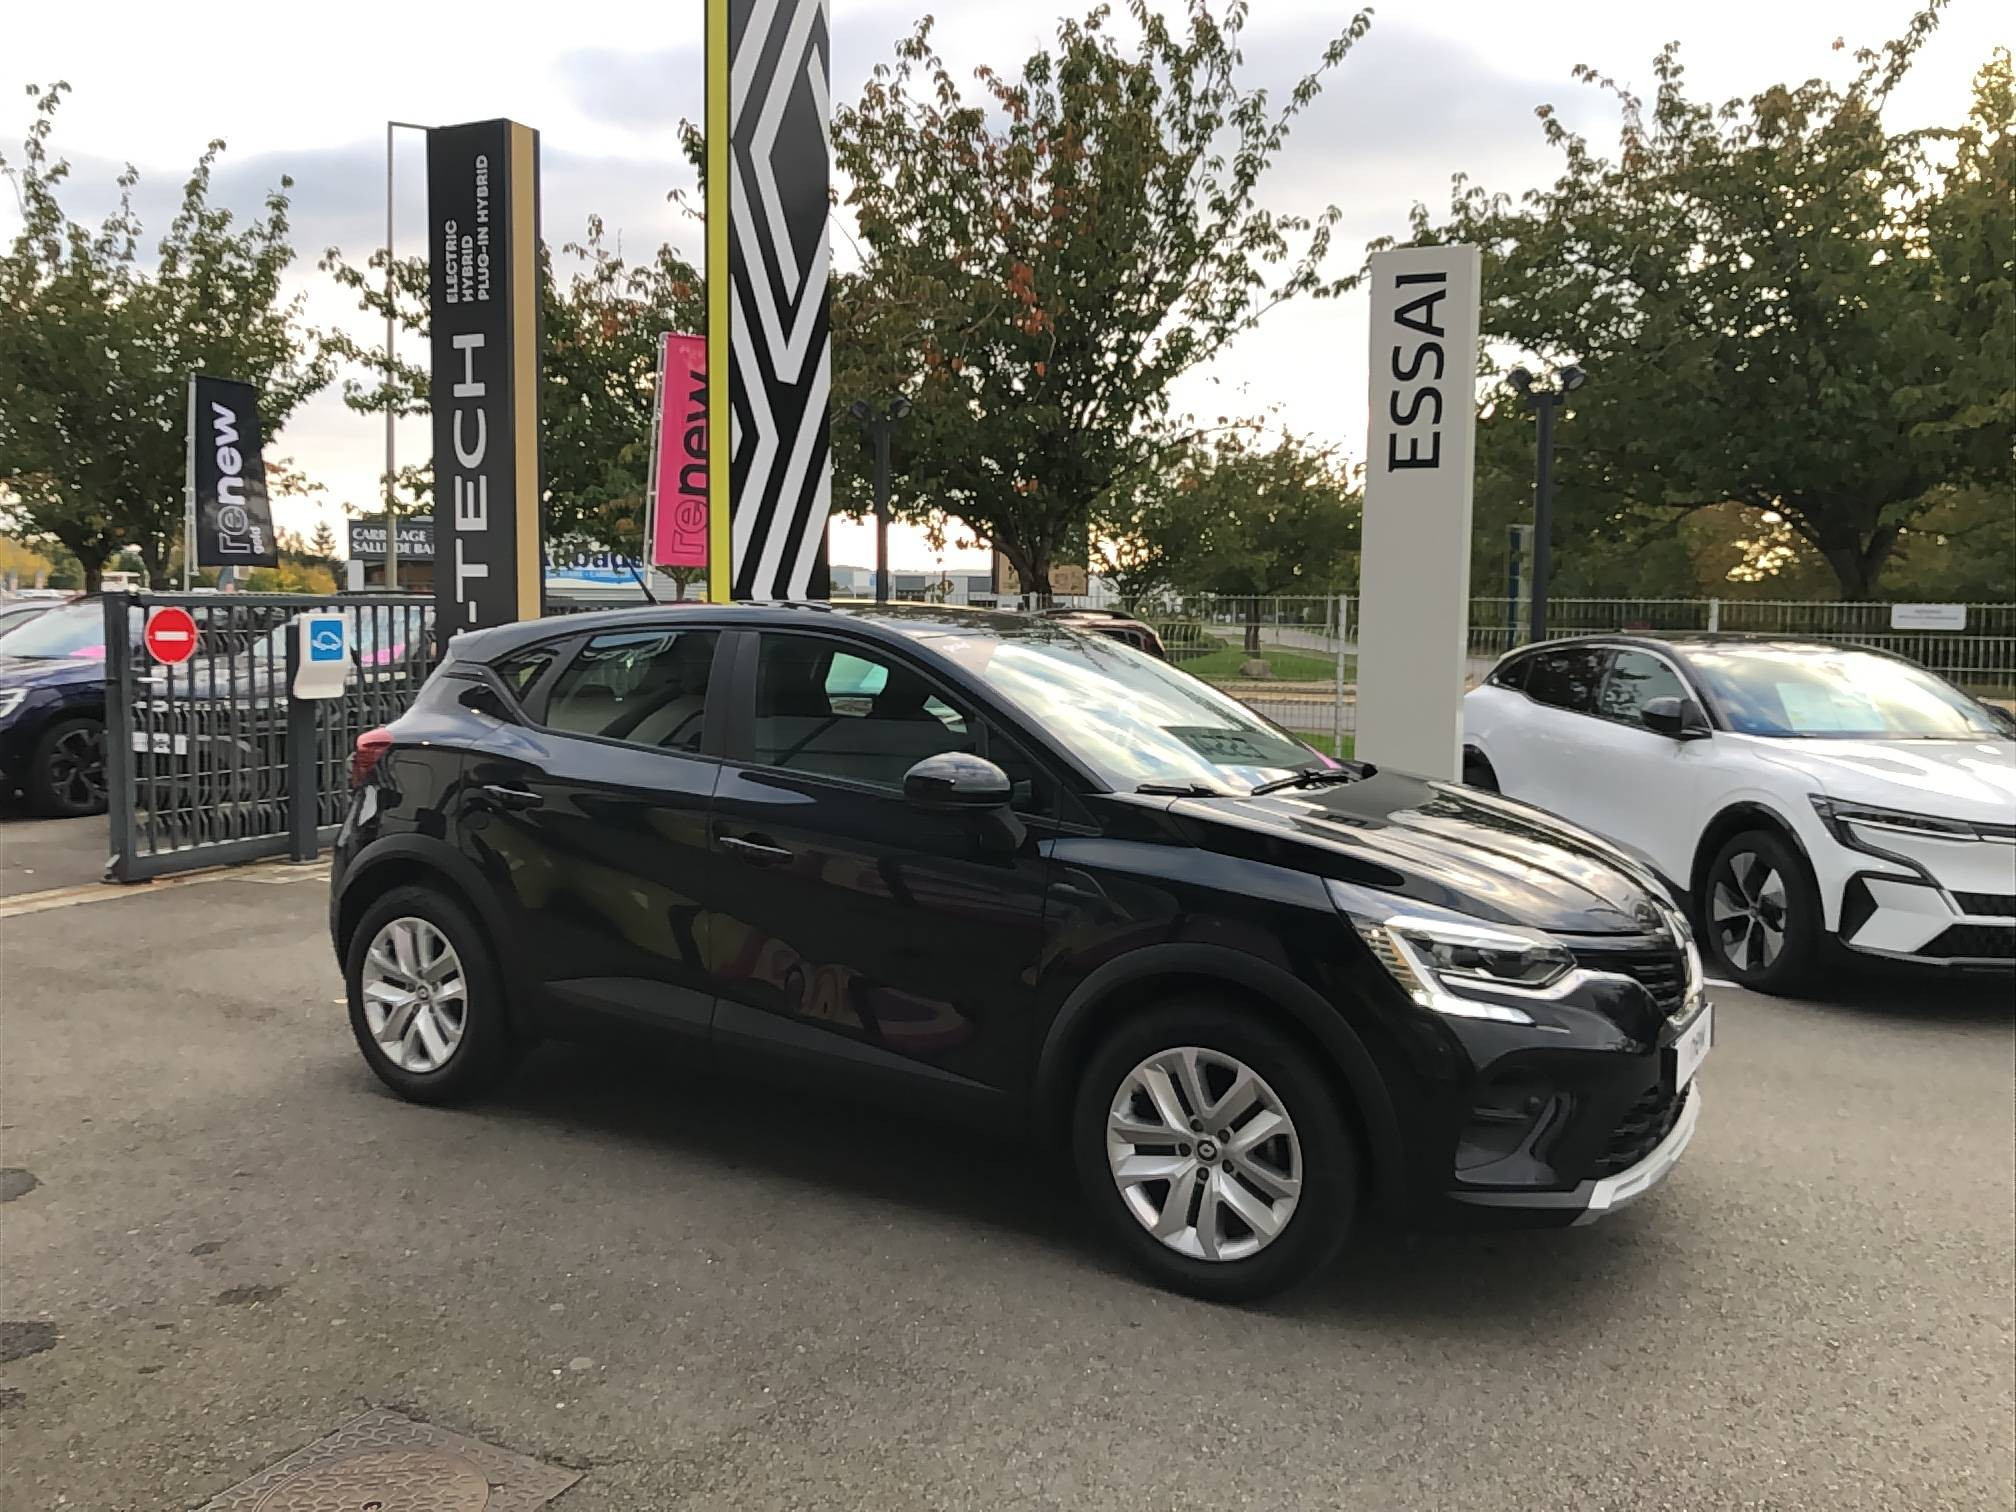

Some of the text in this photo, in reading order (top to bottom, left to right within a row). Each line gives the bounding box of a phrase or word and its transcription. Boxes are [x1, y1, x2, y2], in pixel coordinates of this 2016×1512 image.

[445, 219, 458, 303] ELECTRIC
[461, 235, 474, 302] HYBRID
[476, 155, 489, 300] PLUG-IN HYBRID
[1388, 272, 1447, 473] ESSAI
[212, 401, 251, 554] renew
[352, 528, 426, 542] CARRLAGE
[453, 334, 488, 637] -TECH
[671, 370, 709, 554] renew
